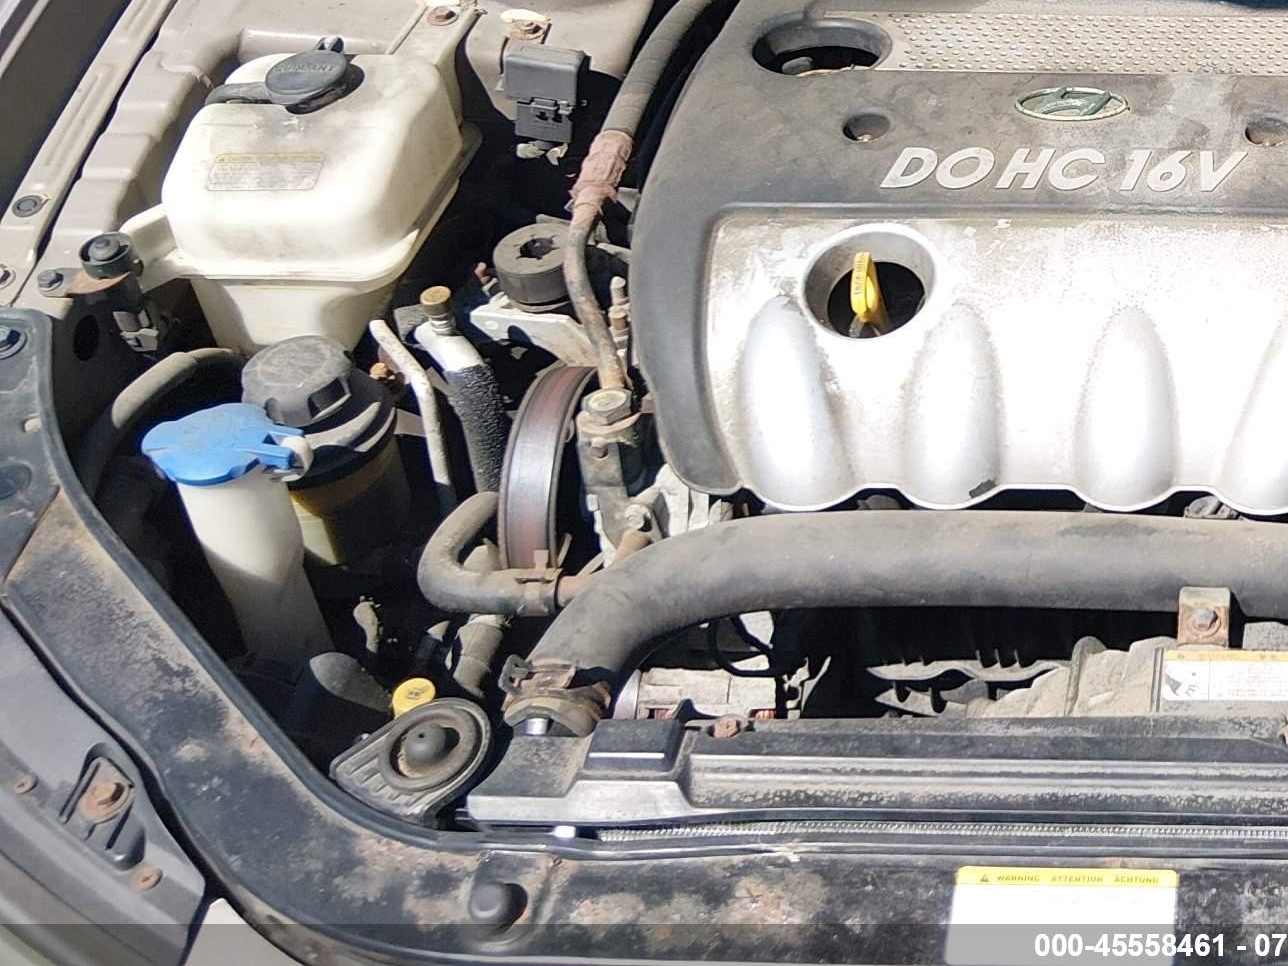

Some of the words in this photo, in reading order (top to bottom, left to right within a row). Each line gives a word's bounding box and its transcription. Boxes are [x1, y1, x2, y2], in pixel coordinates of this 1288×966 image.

[1119, 149, 1249, 193] 16V
[996, 874, 1040, 882] WARNING
[1051, 874, 1104, 883] ATTENTION
[1114, 875, 1159, 884] ACHTUNG
